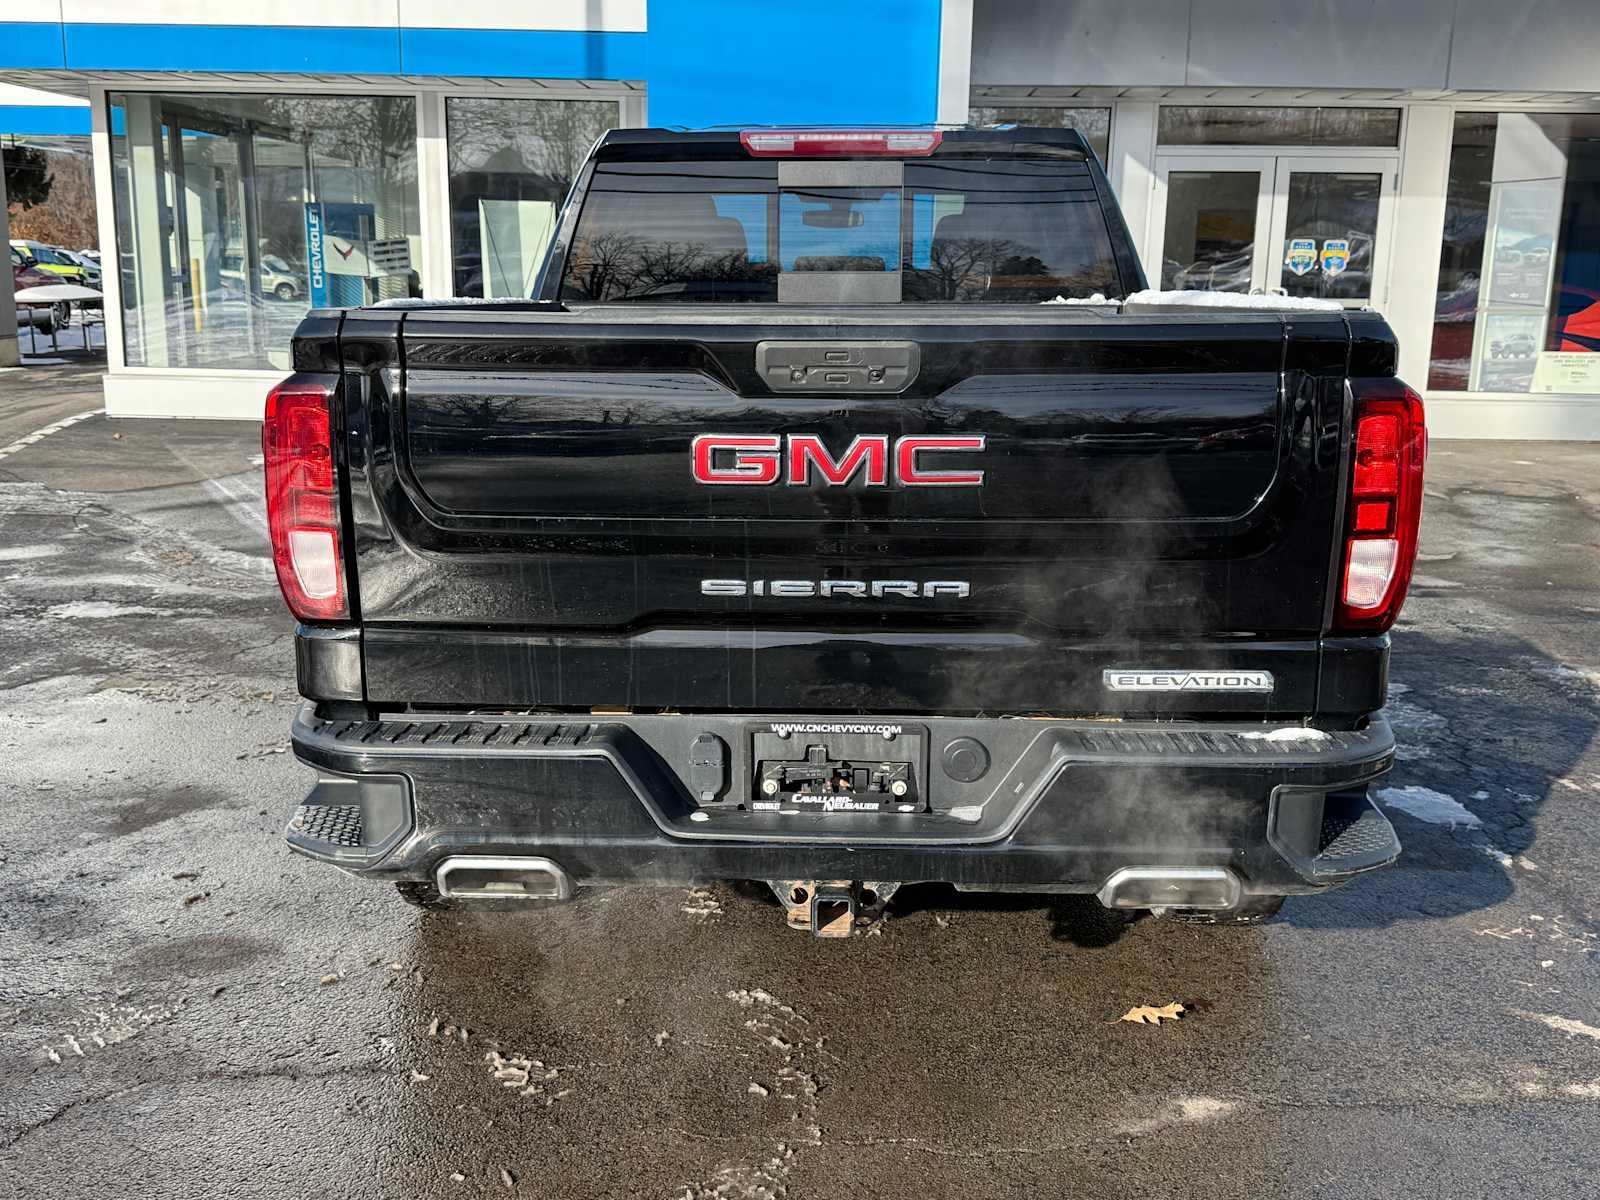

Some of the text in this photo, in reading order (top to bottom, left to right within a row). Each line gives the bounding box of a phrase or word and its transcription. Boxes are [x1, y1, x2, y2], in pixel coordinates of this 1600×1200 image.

[691, 434, 986, 487] GMC
[700, 580, 971, 599] SIERRA
[1117, 674, 1262, 687] ELEVATION
[771, 724, 902, 734] WWW.CNCHEVYCNY.COM
